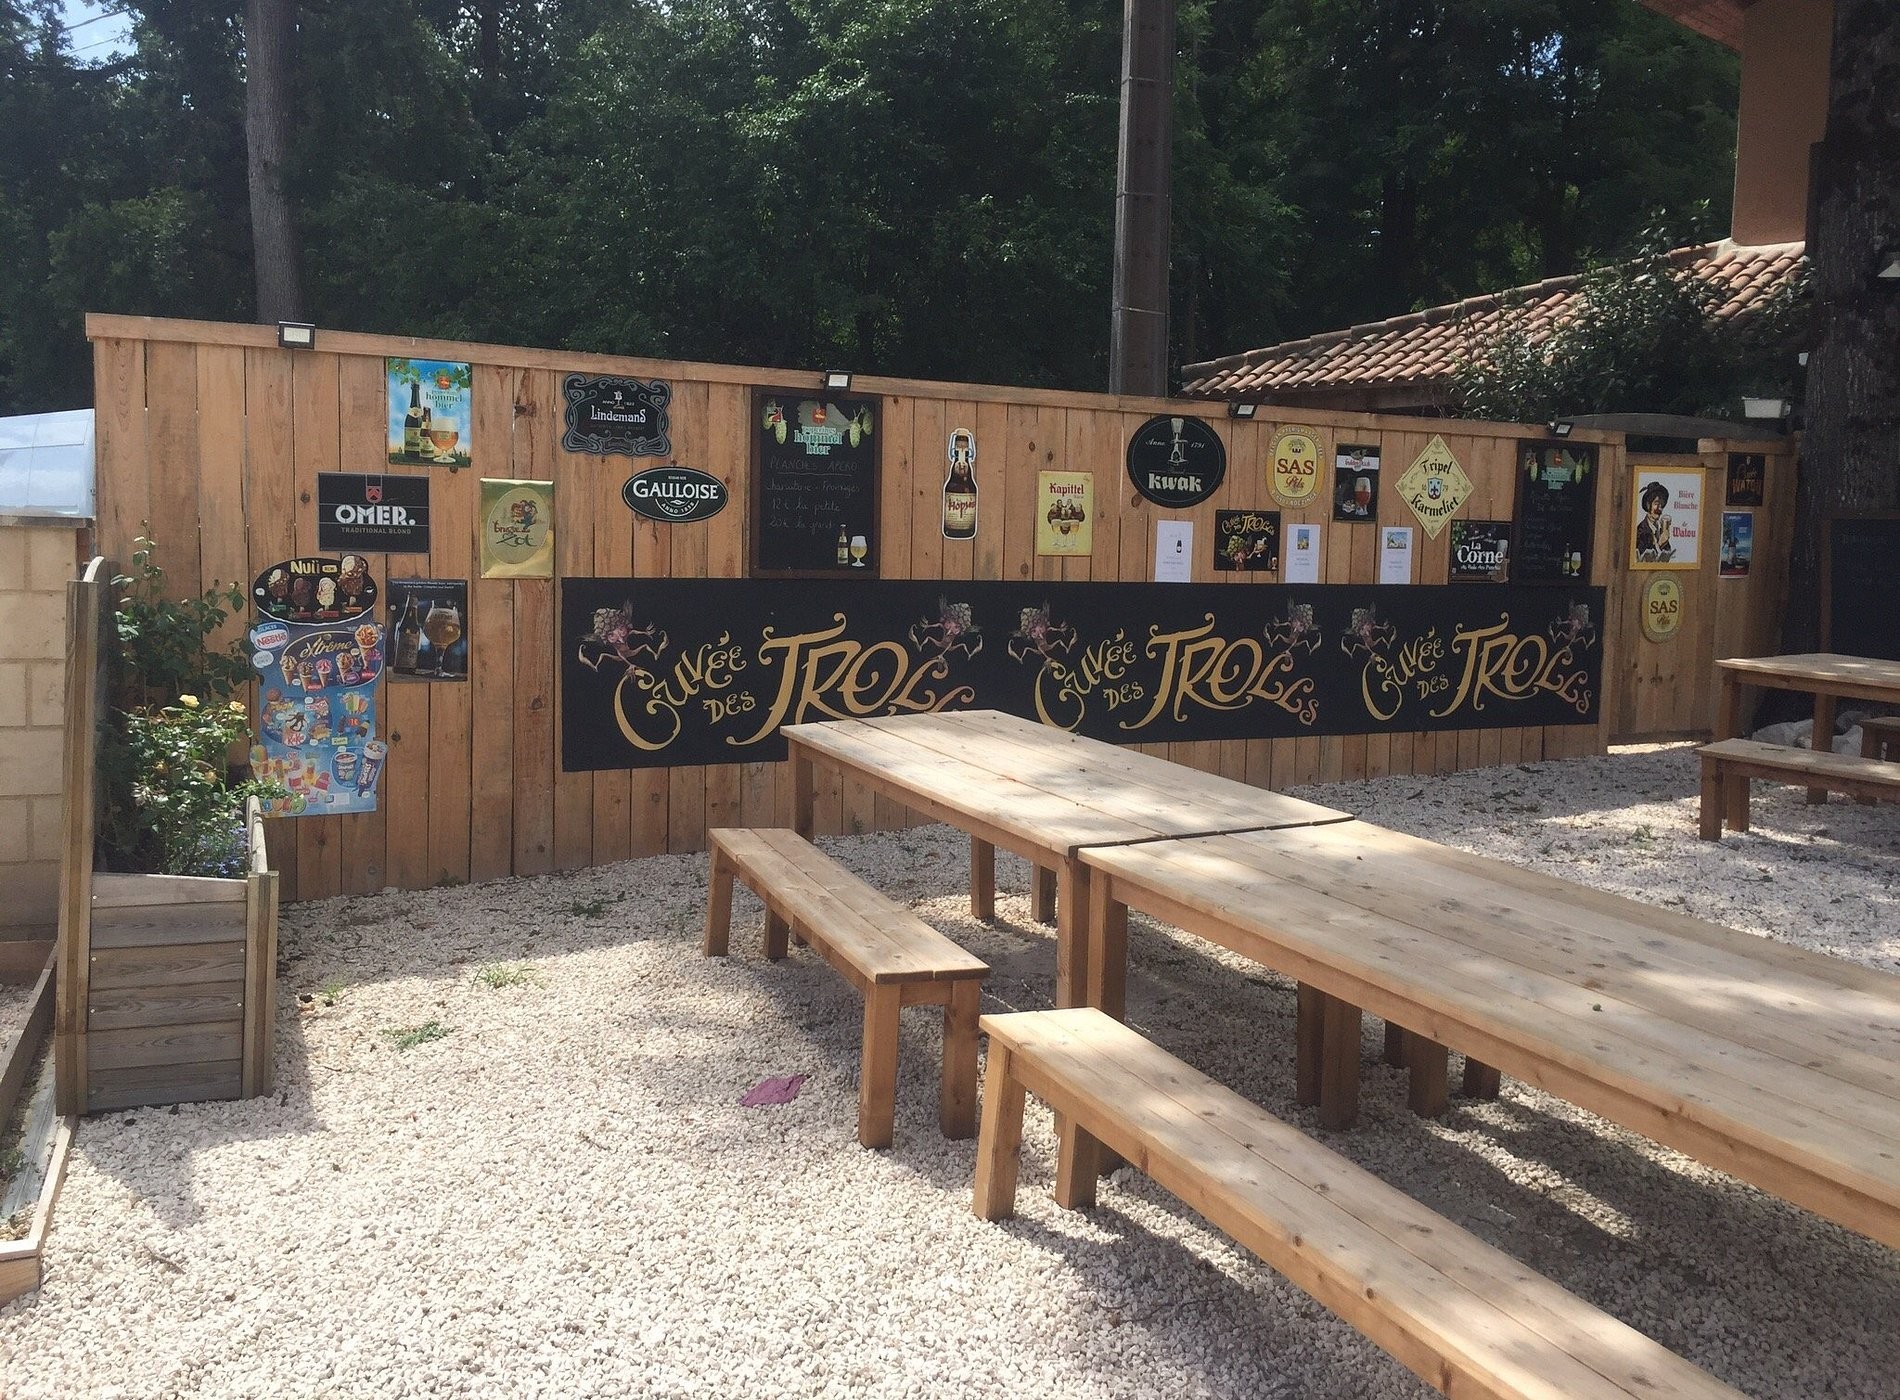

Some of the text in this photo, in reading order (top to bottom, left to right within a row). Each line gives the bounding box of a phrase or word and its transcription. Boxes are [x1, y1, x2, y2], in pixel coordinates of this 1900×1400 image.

[806, 442, 831, 455] bier
[1276, 458, 1315, 476] SAS
[1419, 458, 1454, 475] Tripel
[632, 480, 719, 499] GAULOISE
[1049, 482, 1085, 497] Kapittel
[1284, 475, 1305, 489] Pils
[661, 502, 678, 514] ANNO
[1411, 493, 1459, 517] Karmeliet
[341, 527, 387, 535] TRADITIONAL
[1457, 544, 1504, 564] Corne
[1471, 541, 1482, 550] La
[1649, 600, 1678, 614] SAS
[256, 631, 287, 646] Nestlé
[1118, 612, 1319, 730] TROLLS
[1428, 611, 1592, 718] TROLLS
[1416, 674, 1449, 700] DES
[1102, 681, 1145, 712] DES
[702, 690, 756, 725] DES
